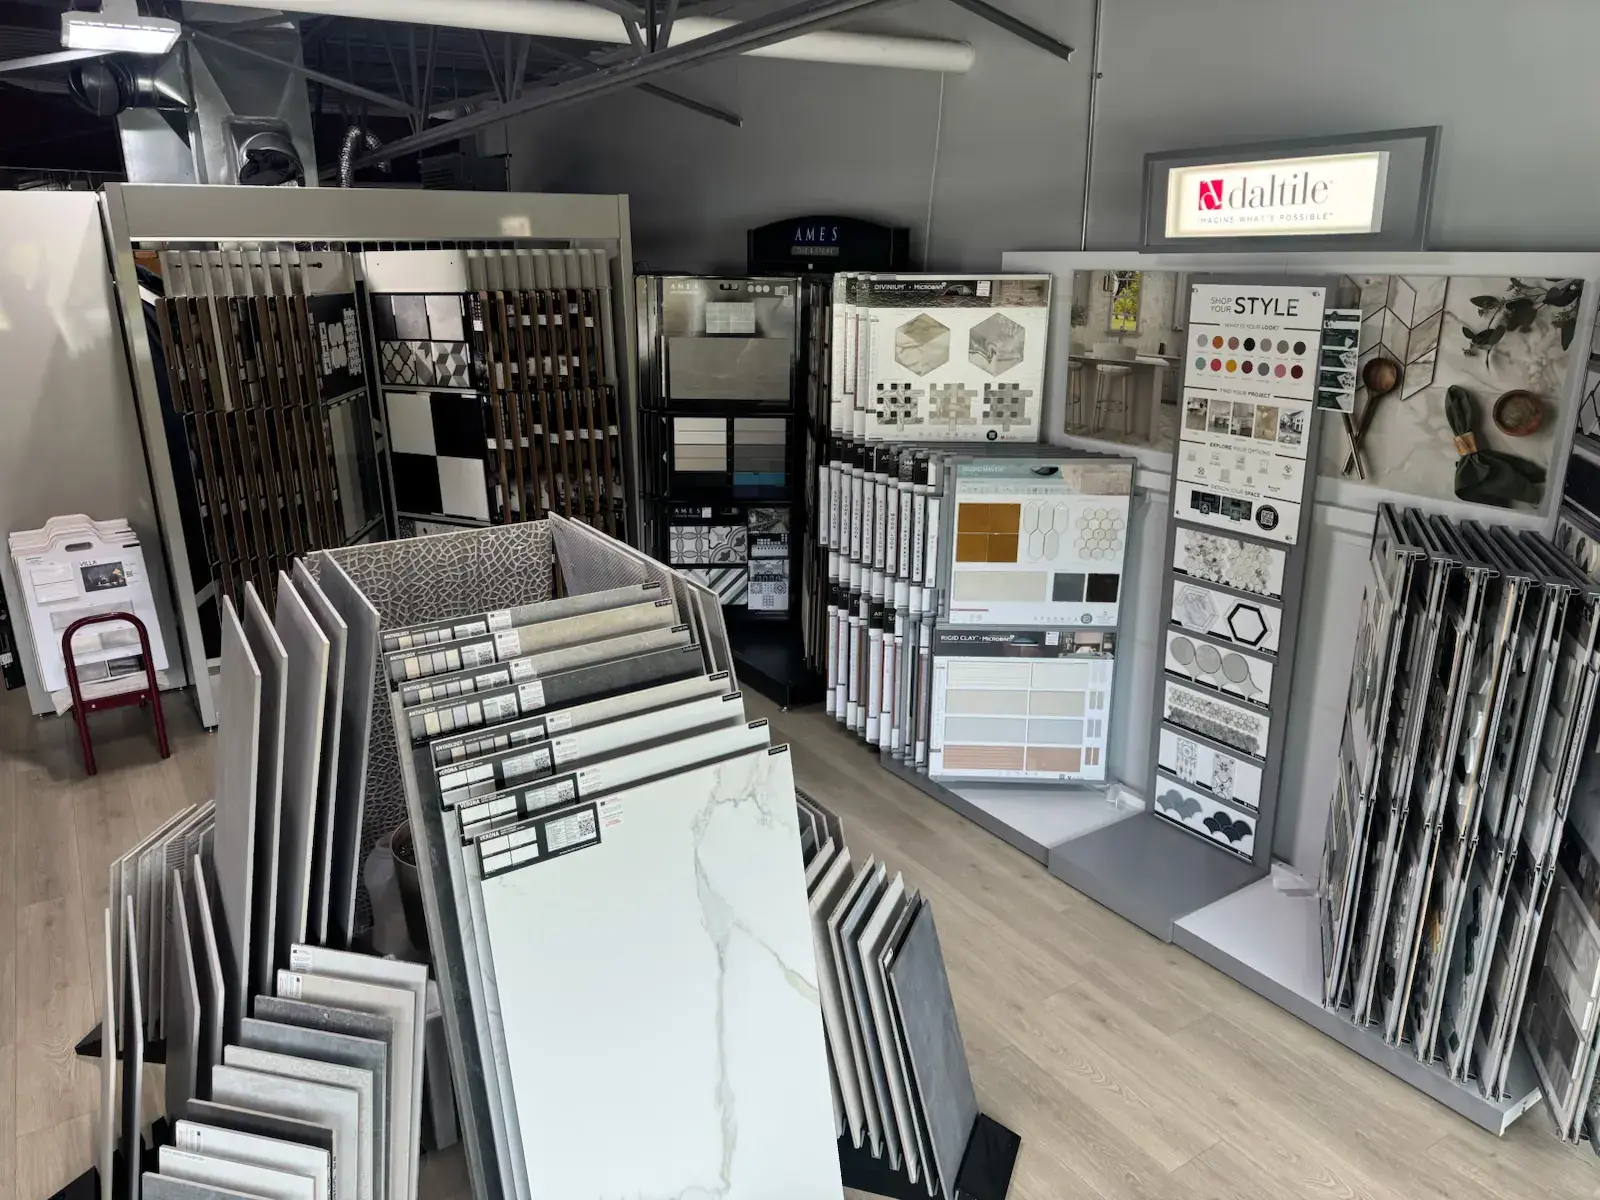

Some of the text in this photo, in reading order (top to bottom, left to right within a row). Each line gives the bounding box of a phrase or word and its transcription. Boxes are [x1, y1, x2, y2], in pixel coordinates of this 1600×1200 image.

[1228, 172, 1329, 210] daltile
[1198, 212, 1328, 225] IMAGINE WHAT'S POSSIBLE
[795, 227, 838, 241] AMES
[1211, 297, 1233, 306] SHOP
[1234, 297, 1300, 317] STYLE
[1211, 306, 1232, 314] YOUR
[1234, 389, 1247, 397] YOUR
[1248, 391, 1270, 399] PROJECT
[1209, 442, 1232, 451] EXPLORE
[1247, 447, 1271, 456] OPTIONS
[1211, 484, 1230, 492] DESIGN
[1244, 489, 1260, 497] SPACE
[460, 799, 481, 809] VERONA
[479, 831, 500, 841] VERONA
